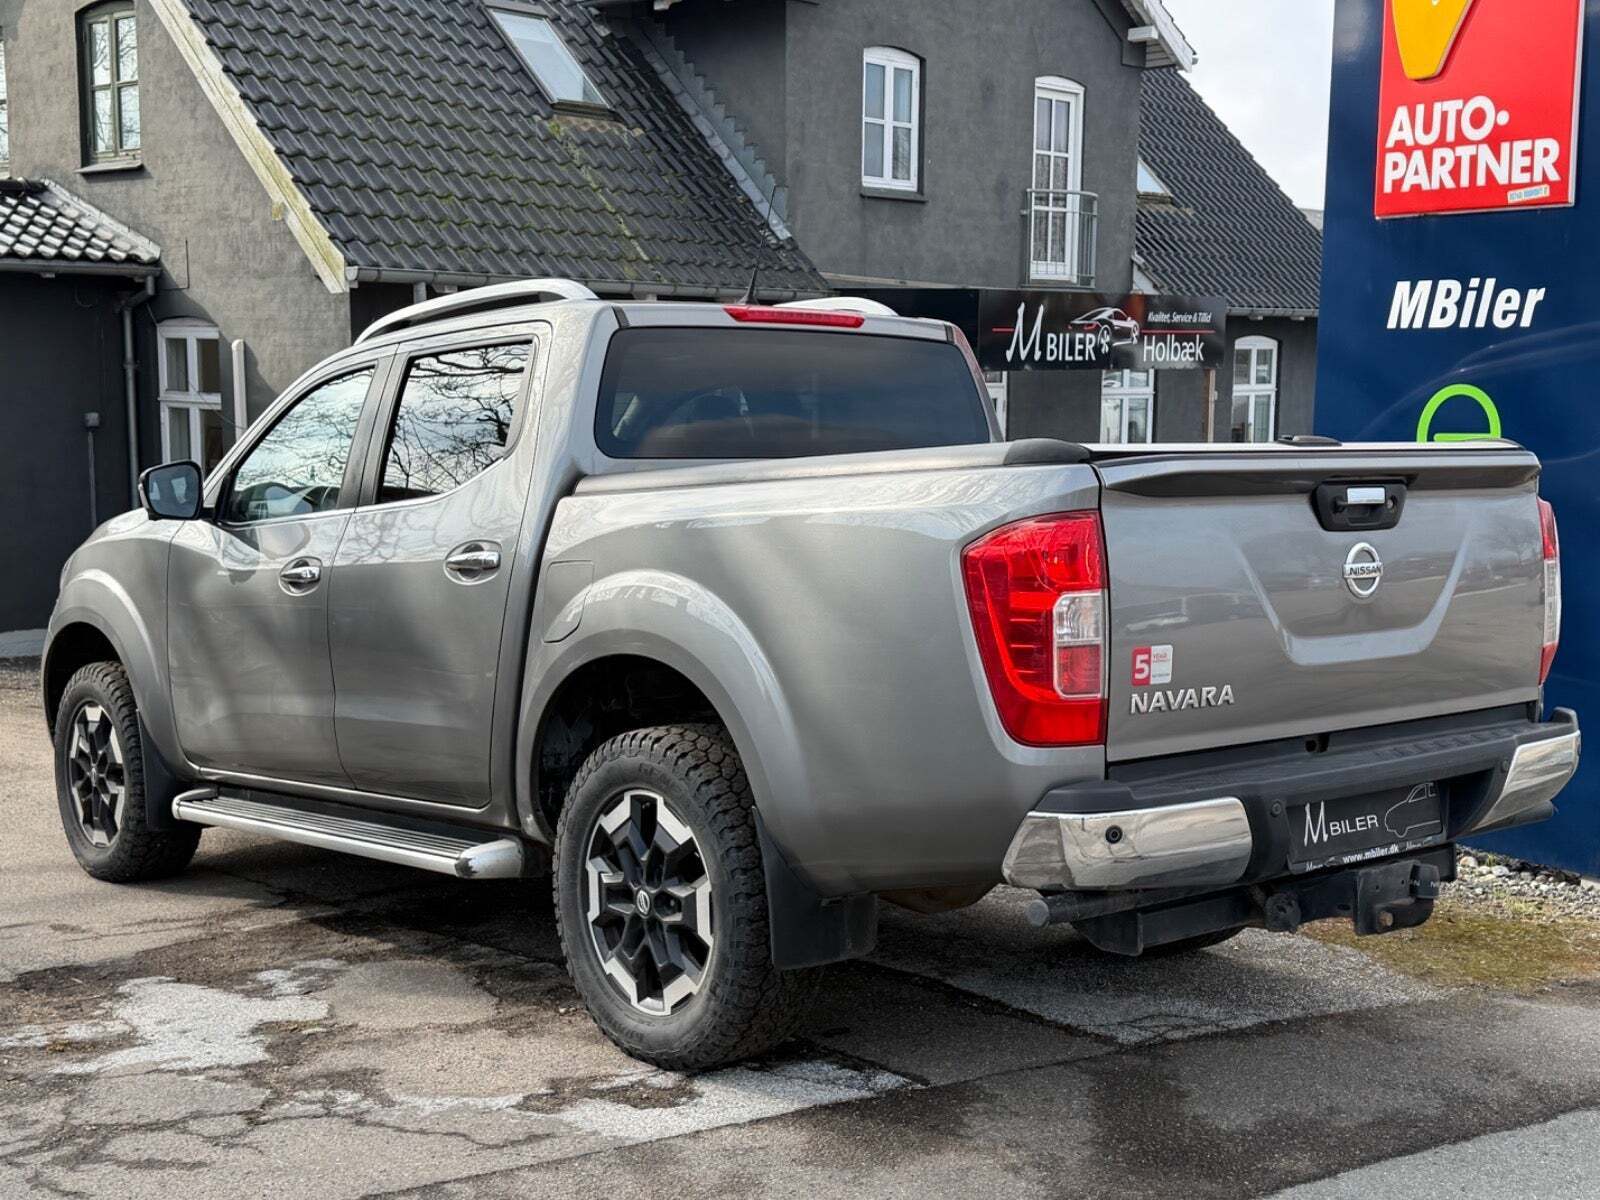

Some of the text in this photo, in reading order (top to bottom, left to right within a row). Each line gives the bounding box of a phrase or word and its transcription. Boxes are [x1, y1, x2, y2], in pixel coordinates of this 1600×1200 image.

[1383, 137, 1561, 193] PARTNER
[1386, 277, 1546, 329] MBiler
[1172, 311, 1192, 323] Service
[1142, 335, 1204, 362] Holbæk
[1349, 565, 1380, 575] NISSAN
[1134, 653, 1150, 680] 5
[1130, 684, 1235, 715] NAVARA
[1342, 843, 1399, 864] www.mbiler.dk
